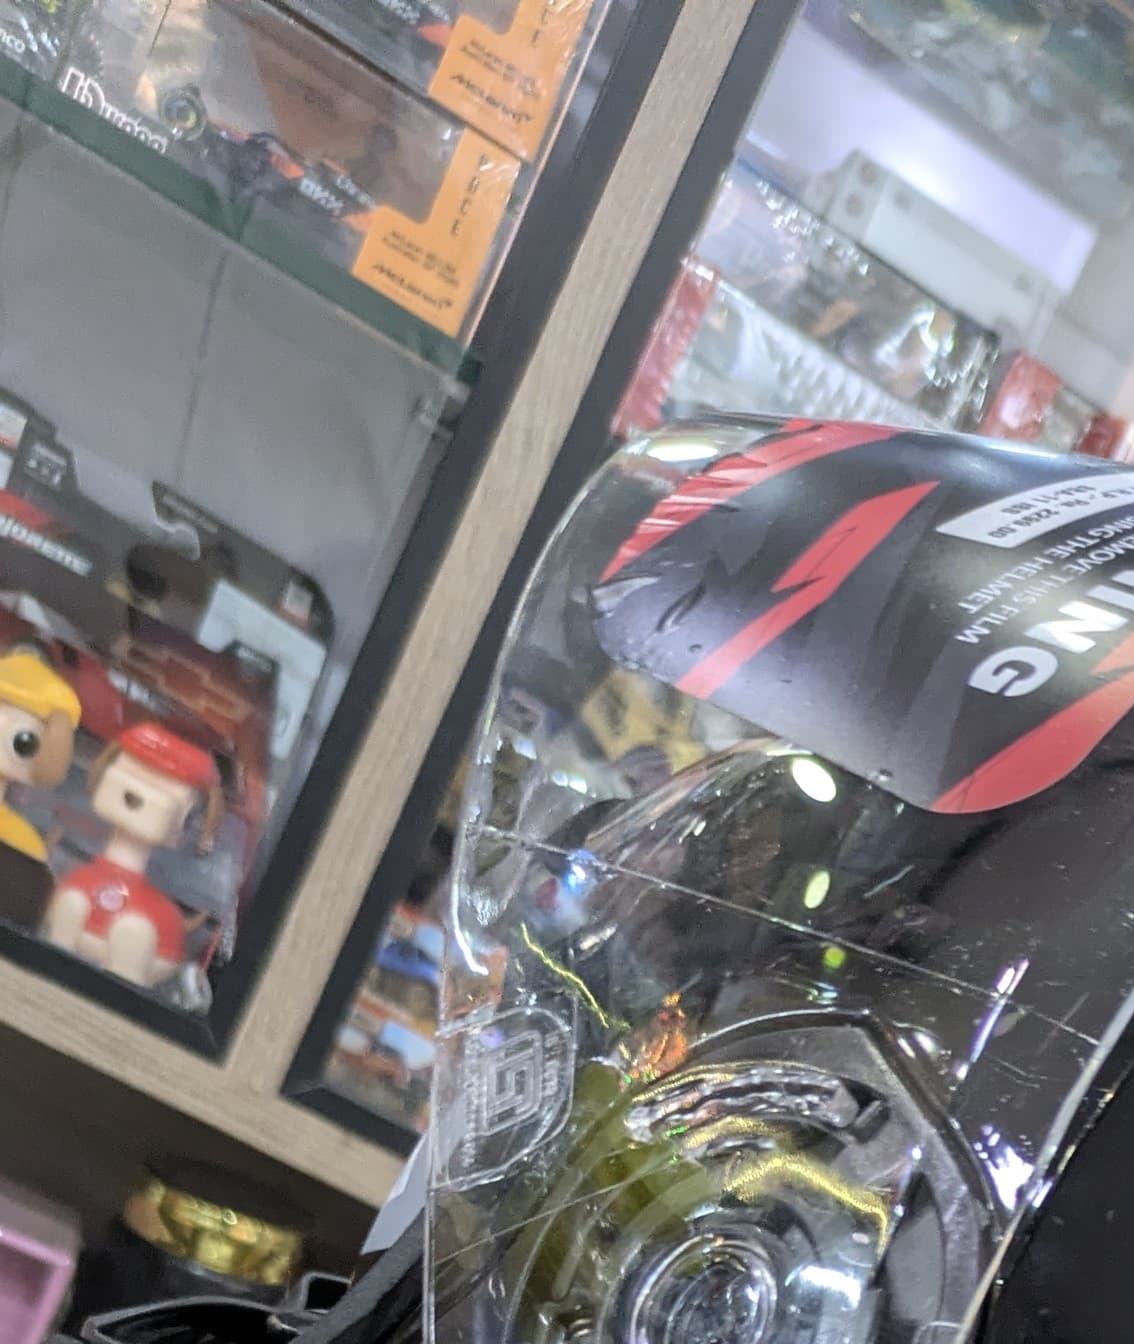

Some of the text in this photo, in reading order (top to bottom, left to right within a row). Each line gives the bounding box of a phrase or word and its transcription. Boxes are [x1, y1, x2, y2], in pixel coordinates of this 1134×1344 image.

[1043, 535, 1101, 560] THE
[957, 556, 1055, 615] HELMET
[1013, 573, 1075, 604] THIS
[954, 603, 1020, 644] FILM
